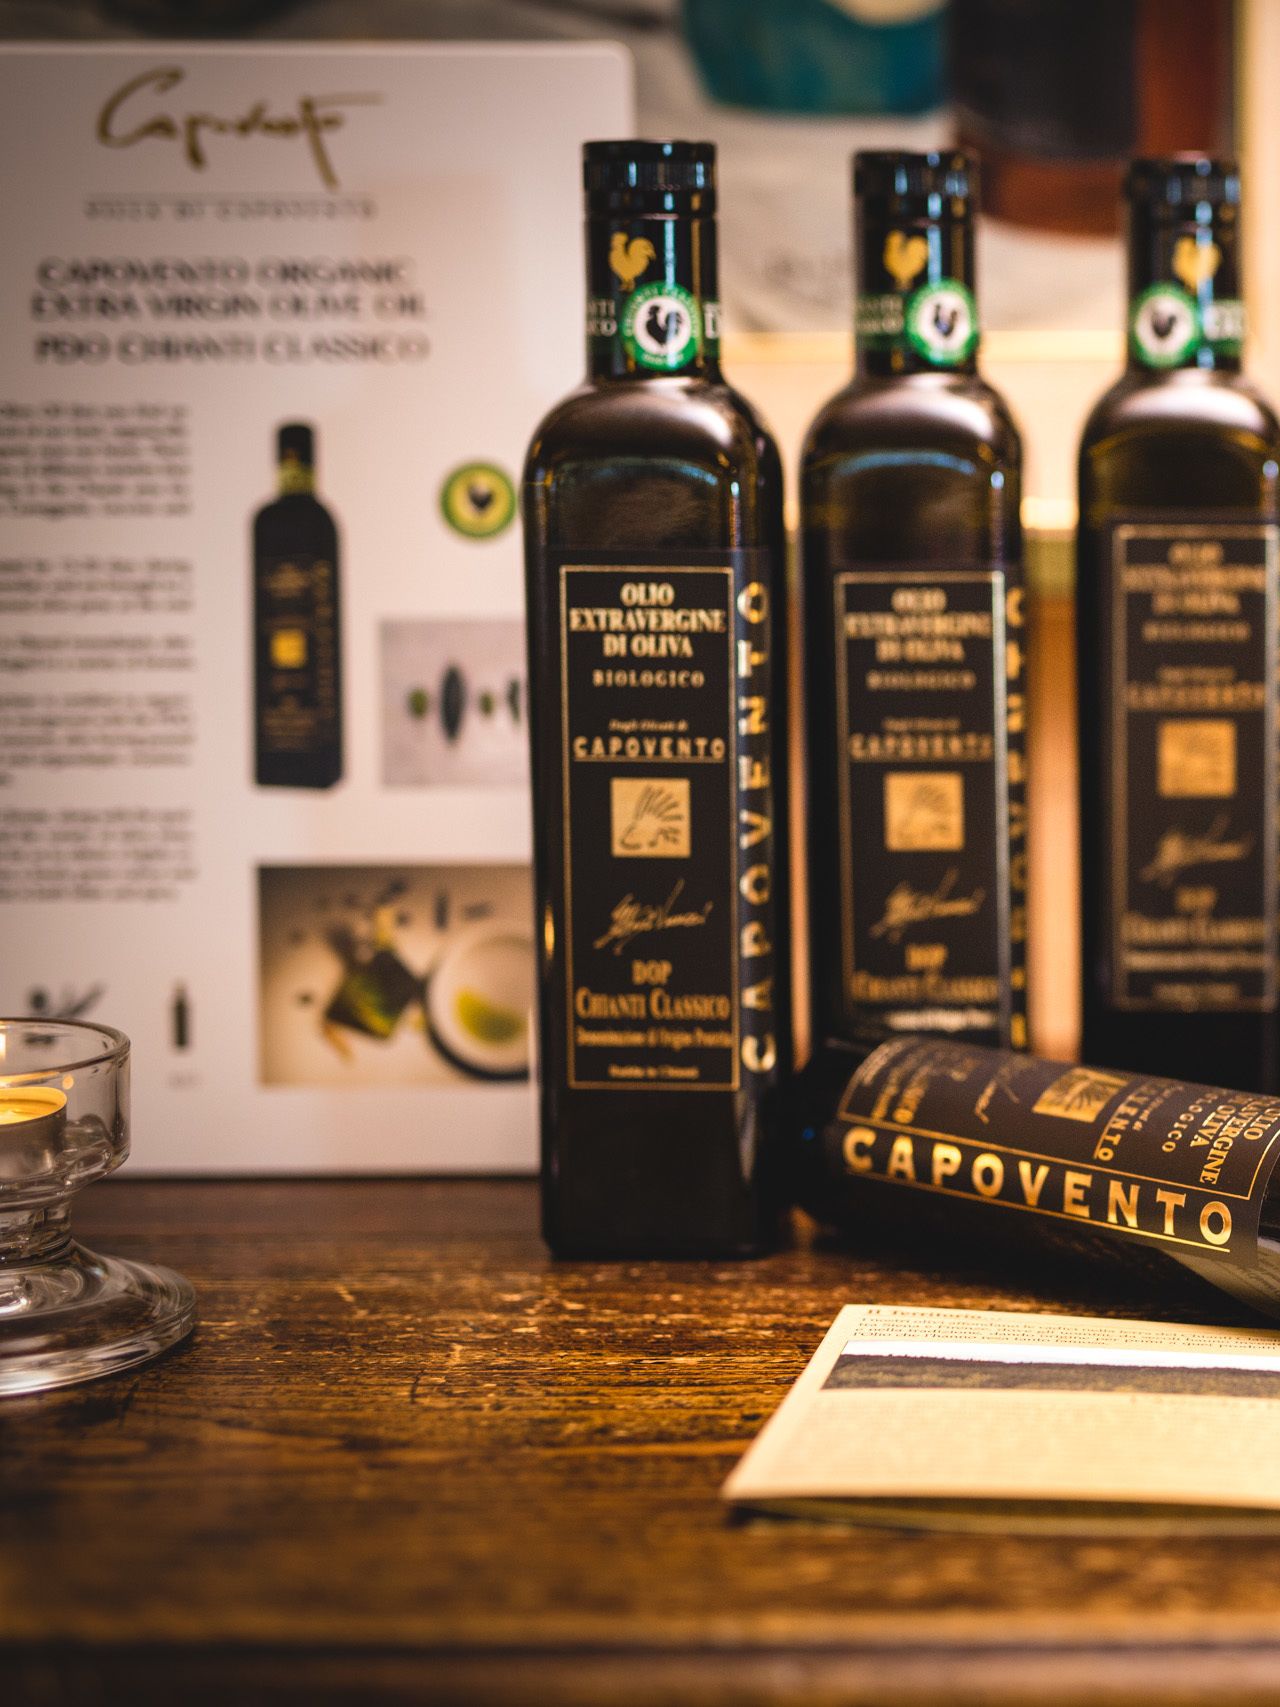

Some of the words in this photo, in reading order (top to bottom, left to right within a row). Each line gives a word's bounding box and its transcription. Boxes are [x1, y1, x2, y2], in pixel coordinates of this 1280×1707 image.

[38, 256, 249, 290] CAPOVENTO
[256, 256, 415, 290] ORGANIC
[31, 291, 142, 322] EXTRA
[149, 291, 261, 322] VIRGIN
[267, 291, 362, 322] OLIVE
[373, 291, 427, 322] OIL
[35, 331, 111, 365] PDO
[117, 331, 257, 365] CHIANTI
[262, 331, 432, 367] CLASSICO
[620, 582, 675, 607] OLIO
[891, 588, 947, 613] OLIO
[569, 607, 727, 633] EXTRAVERGINE
[845, 612, 993, 639] EXTRAVERGINE
[603, 634, 627, 657] DI
[631, 634, 694, 658] OLIVA
[875, 640, 901, 662] DI
[904, 640, 964, 662] OLIVA
[593, 669, 705, 688] BIOLOGICO
[573, 735, 726, 762] CAPOVENTO
[1190, 1104, 1236, 1147] OLIVA
[841, 1125, 1234, 1246] CAPOVENTO
